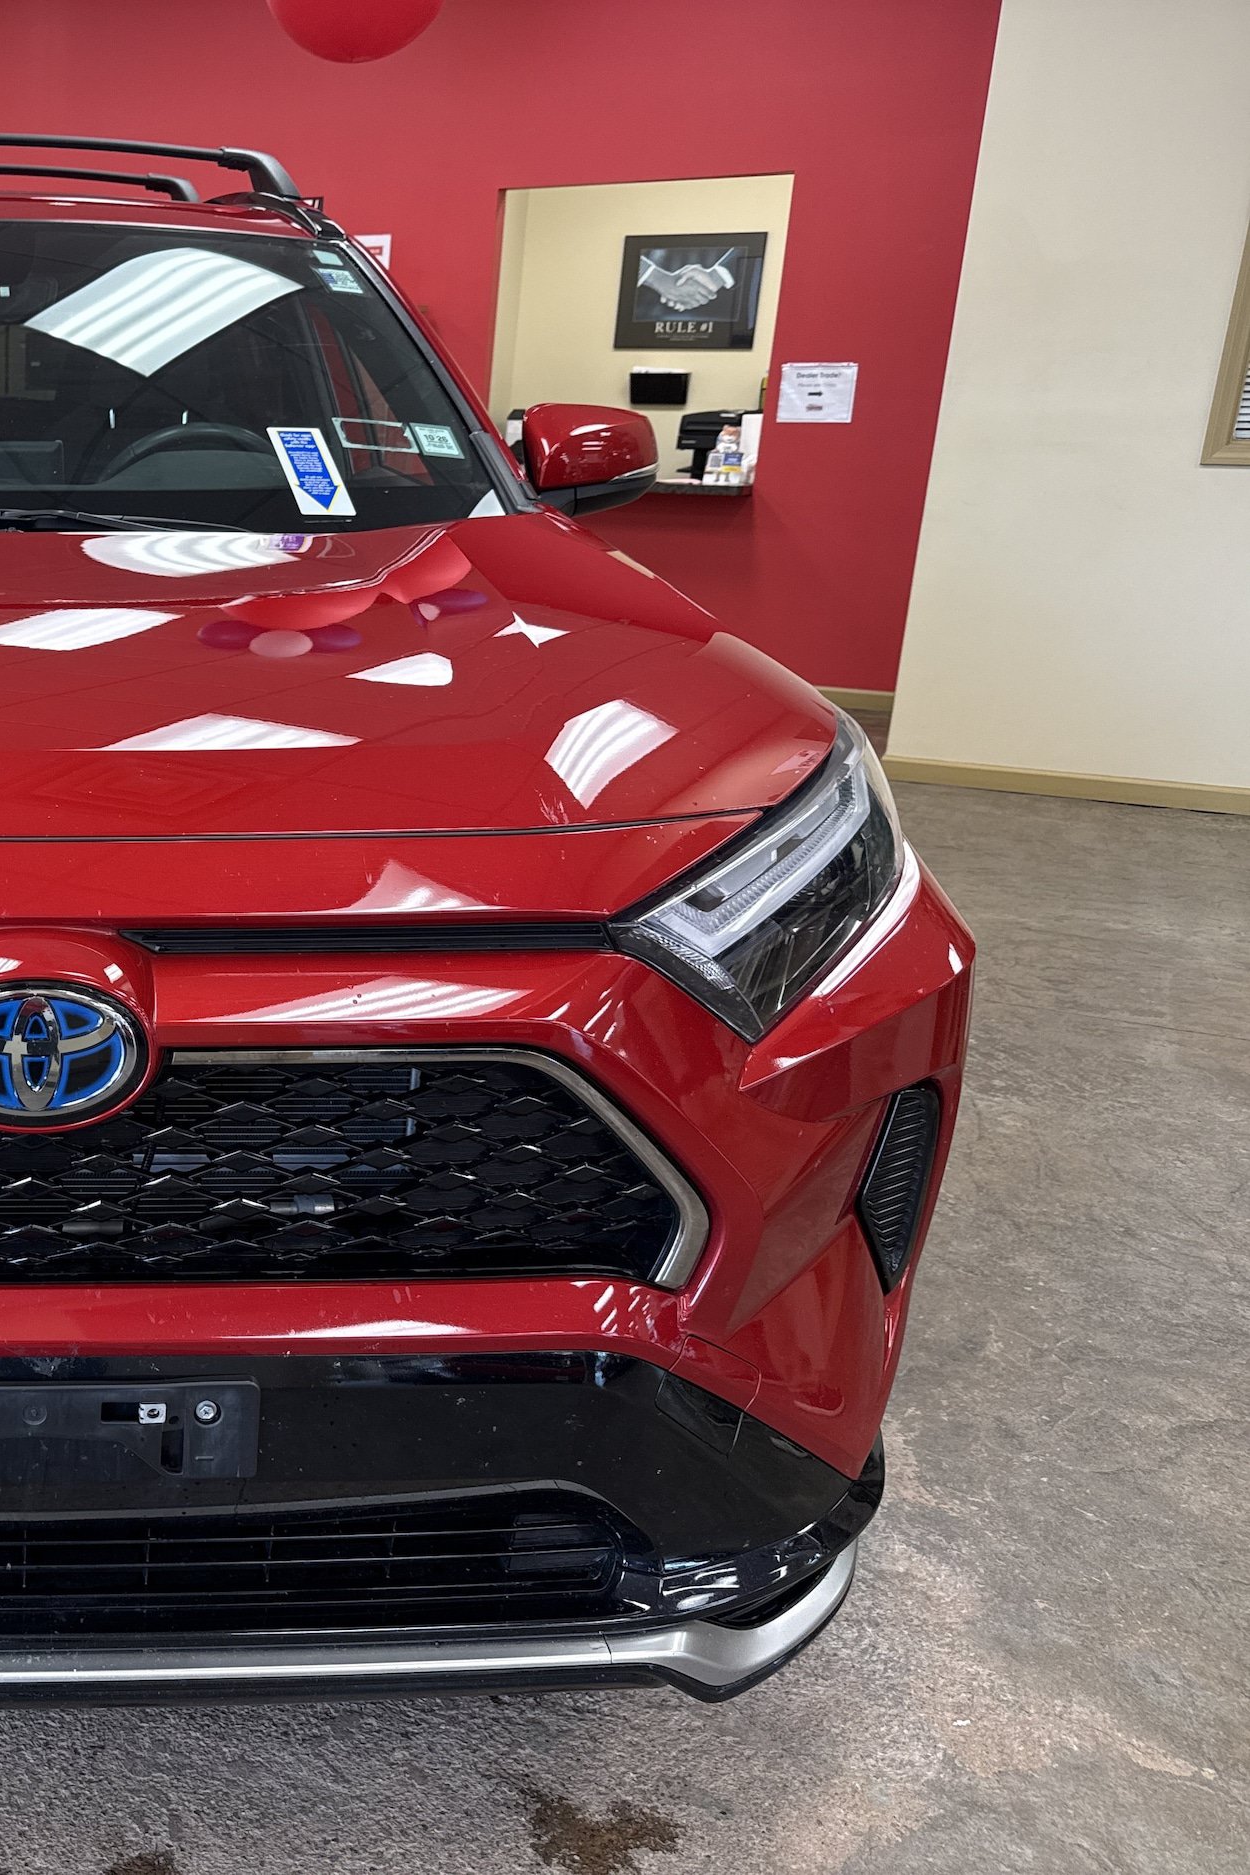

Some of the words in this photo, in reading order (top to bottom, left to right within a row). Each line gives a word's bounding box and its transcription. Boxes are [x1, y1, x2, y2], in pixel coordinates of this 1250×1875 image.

[654, 321, 697, 334] RULE
[699, 321, 714, 334] #1
[796, 371, 818, 379] Dealer
